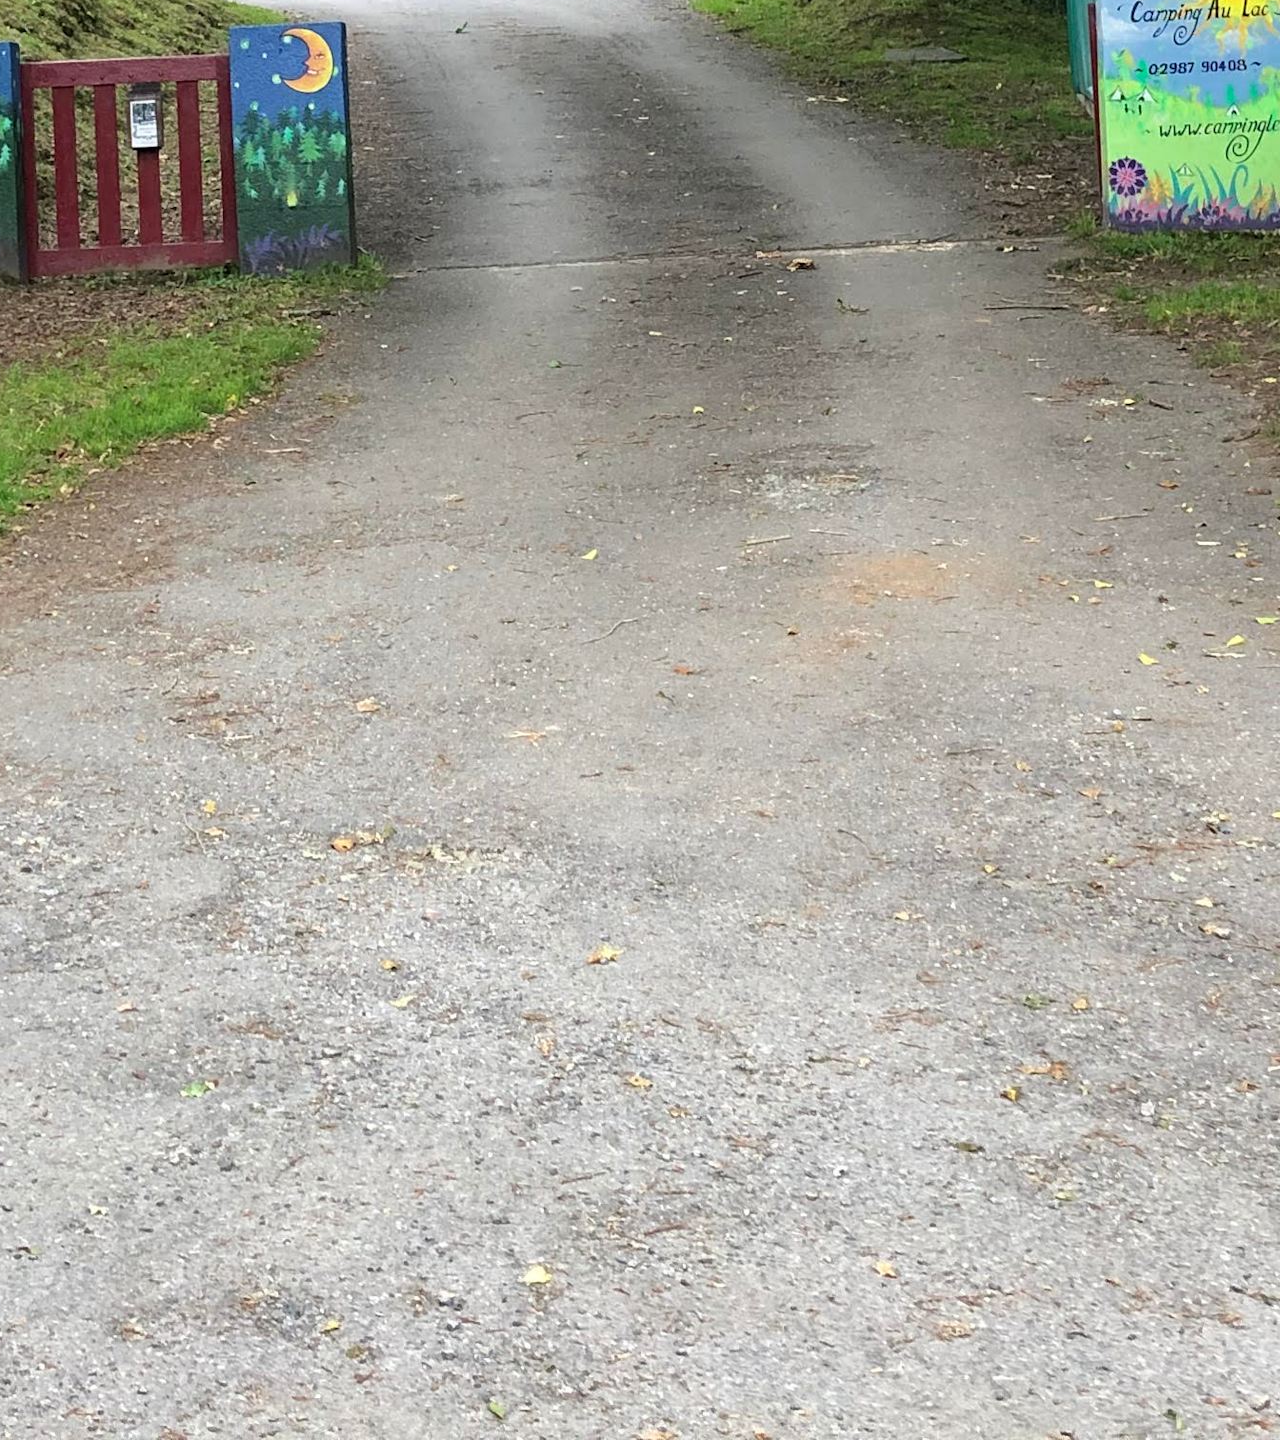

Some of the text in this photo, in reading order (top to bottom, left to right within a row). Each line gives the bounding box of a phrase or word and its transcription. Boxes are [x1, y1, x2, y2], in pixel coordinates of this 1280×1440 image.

[1130, 0, 1202, 46] Camping
[1148, 59, 1247, 75] 02987 90408
